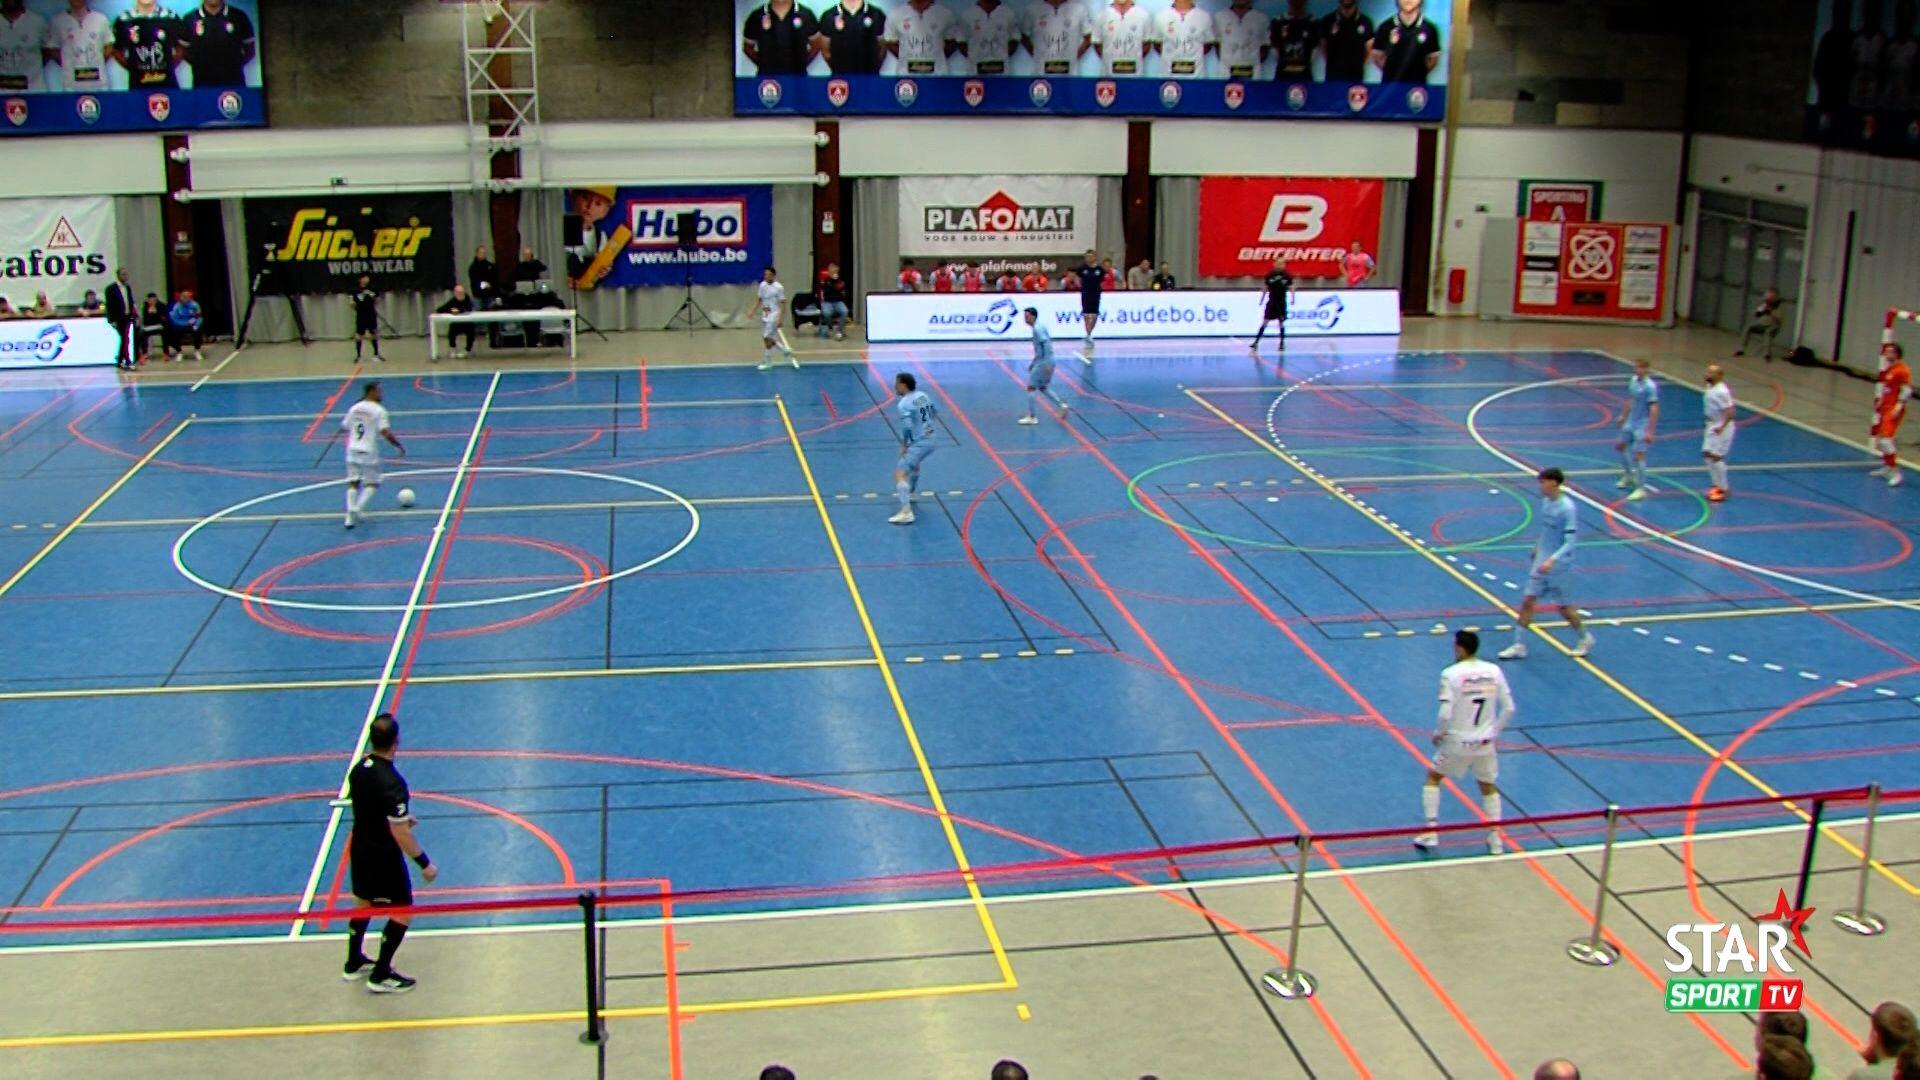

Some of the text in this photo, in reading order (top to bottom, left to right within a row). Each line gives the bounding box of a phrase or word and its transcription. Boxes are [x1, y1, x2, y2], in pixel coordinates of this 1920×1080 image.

[927, 207, 1071, 231] PLAFOMAT
[1258, 193, 1328, 242] B
[0, 249, 107, 278] afors
[628, 248, 748, 265] www.hubo.be
[1237, 247, 1347, 261] BETCENTER
[929, 314, 1002, 324] AUDEBO
[1472, 697, 1486, 726] 7
